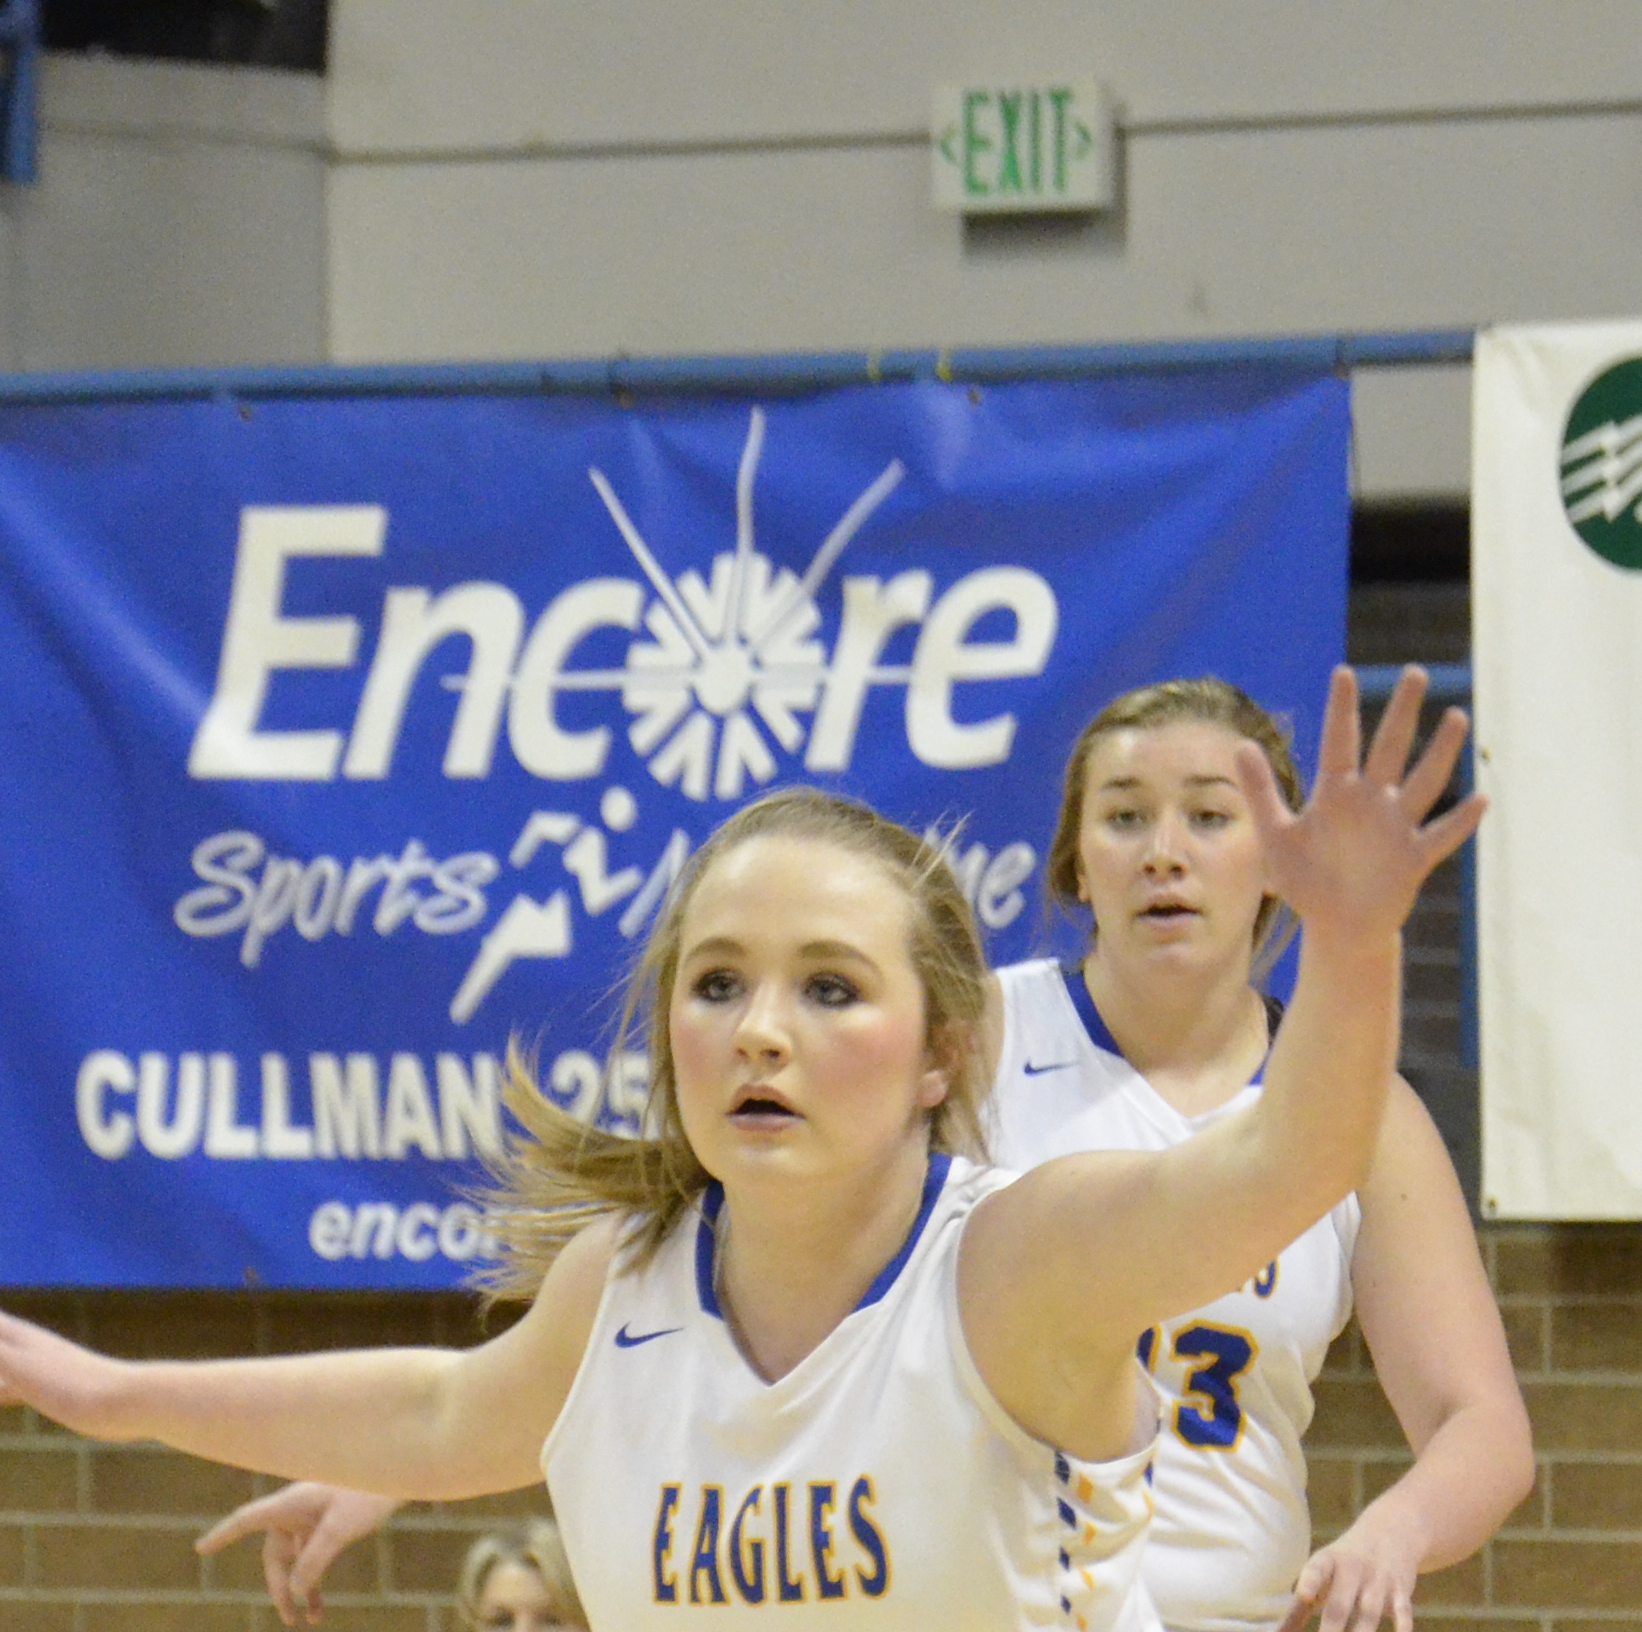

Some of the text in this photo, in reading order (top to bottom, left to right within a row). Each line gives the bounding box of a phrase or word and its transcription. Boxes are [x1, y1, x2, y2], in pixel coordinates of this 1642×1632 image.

[962, 87, 1074, 193] EXIT
[172, 828, 501, 968] Sports
[74, 1048, 509, 1162] CULLMAN
[651, 1472, 893, 1607] EAGLES
